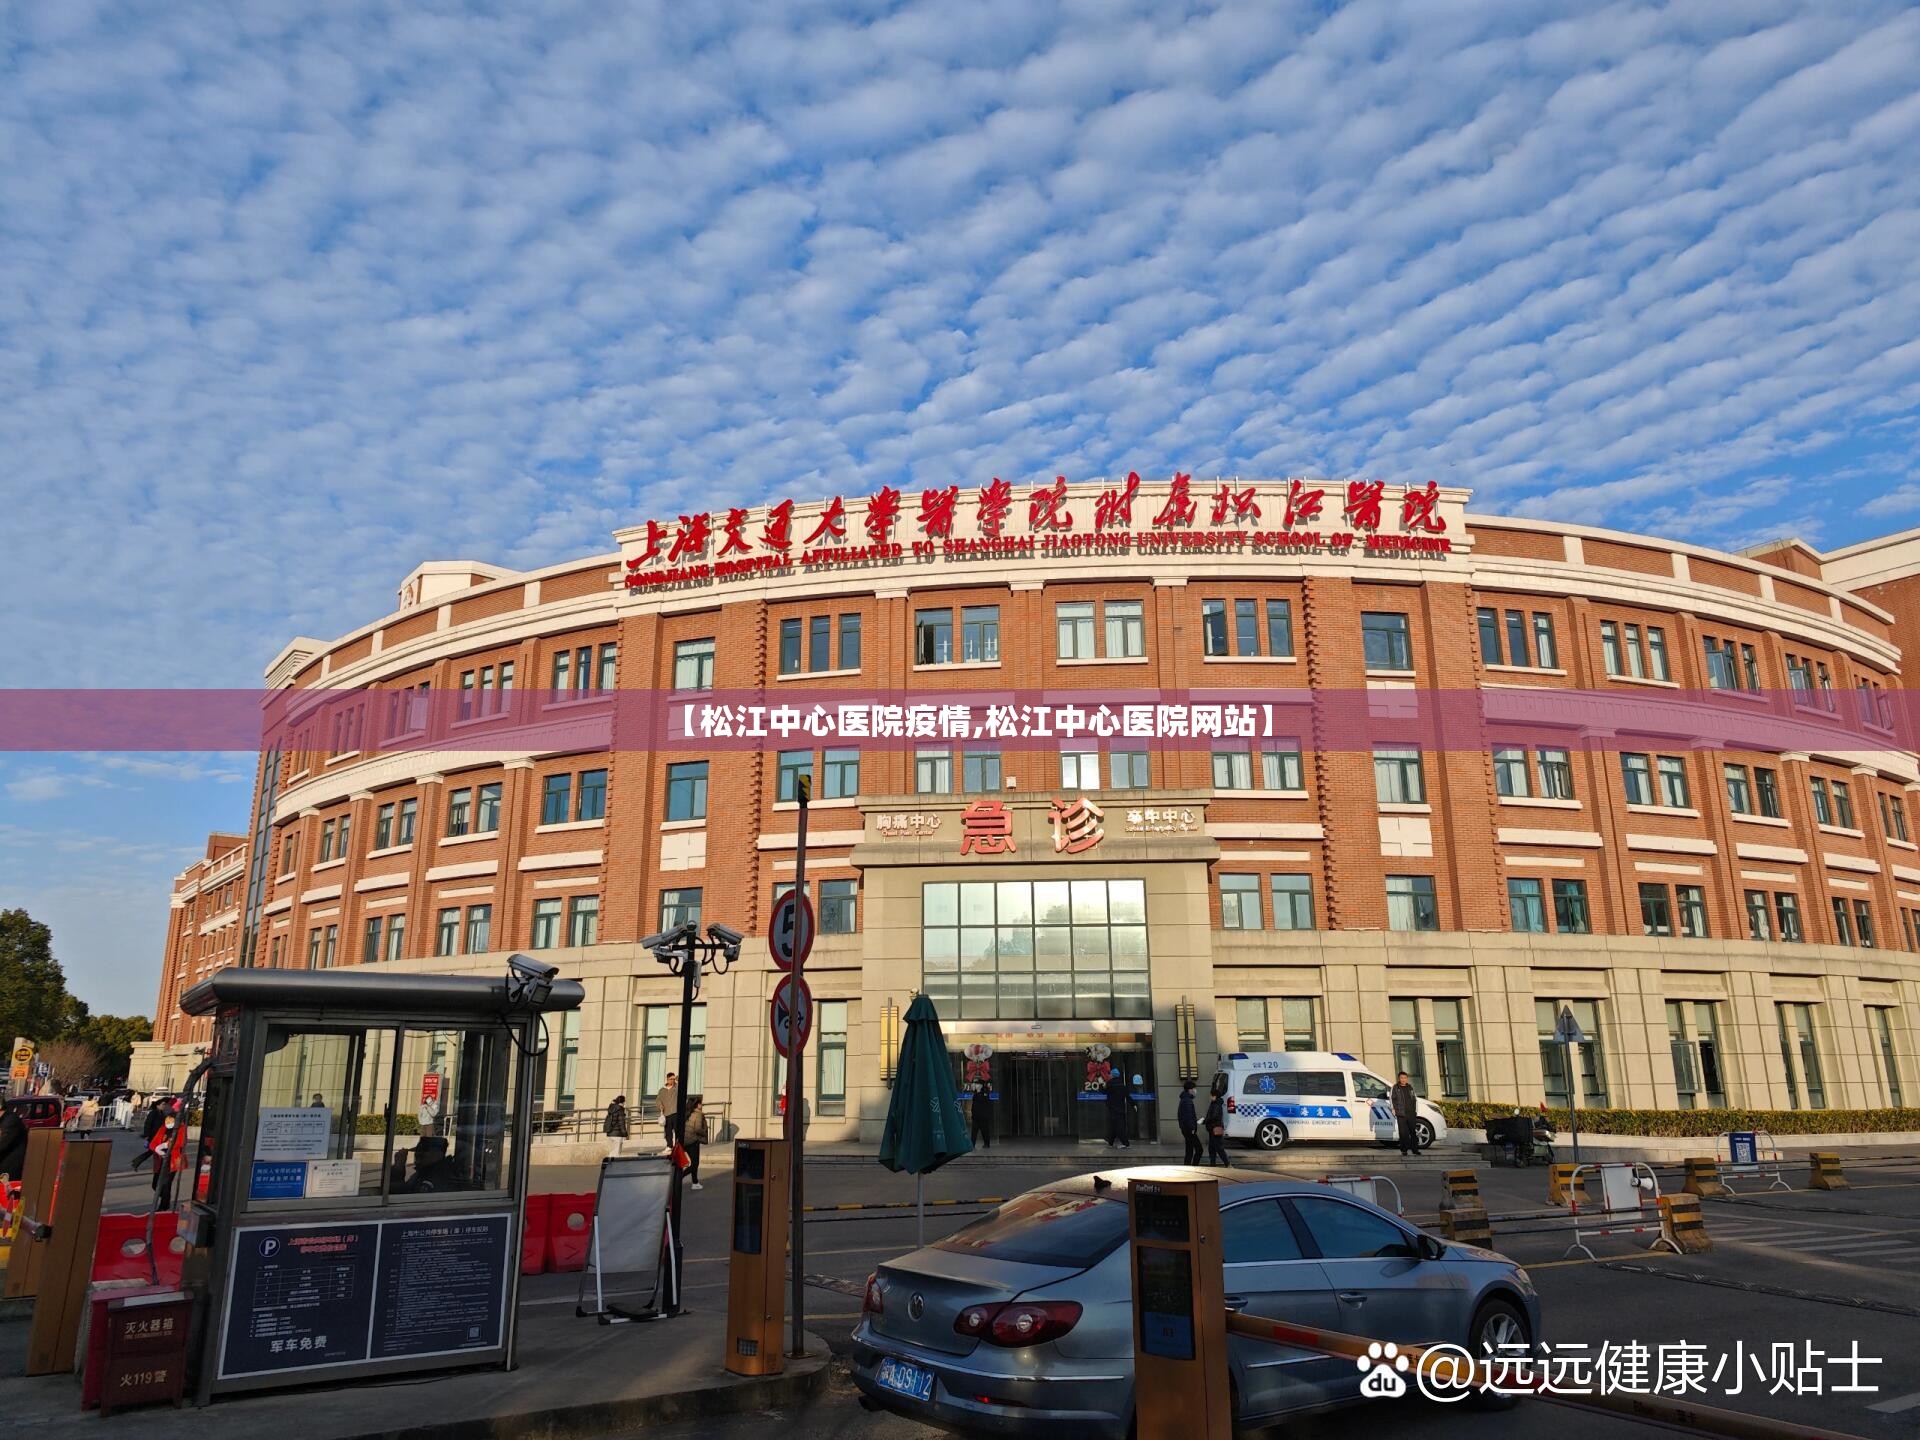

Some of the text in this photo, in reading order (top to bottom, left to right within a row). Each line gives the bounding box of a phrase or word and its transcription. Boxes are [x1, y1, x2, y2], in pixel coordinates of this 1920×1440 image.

[714, 552, 793, 577] HOSPITAL
[799, 542, 903, 565] AFFILIATED
[912, 540, 935, 556] TO
[943, 535, 1035, 553] SHANGHAI
[1041, 532, 1131, 551] JIAOTONG
[1137, 531, 1248, 547] UNIVERSITY
[1253, 531, 1326, 547] SCHOOL
[1331, 532, 1354, 547] OF
[1365, 534, 1451, 553] MEDICINE
[876, 814, 941, 830] 胸痛中心
[1126, 808, 1196, 825] 卒中中心
[960, 797, 1105, 855] 急诊
[1286, 1107, 1341, 1117] 上海急救
[124, 1317, 174, 1334] 灭火器箱
[269, 1335, 328, 1353] 军车免费
